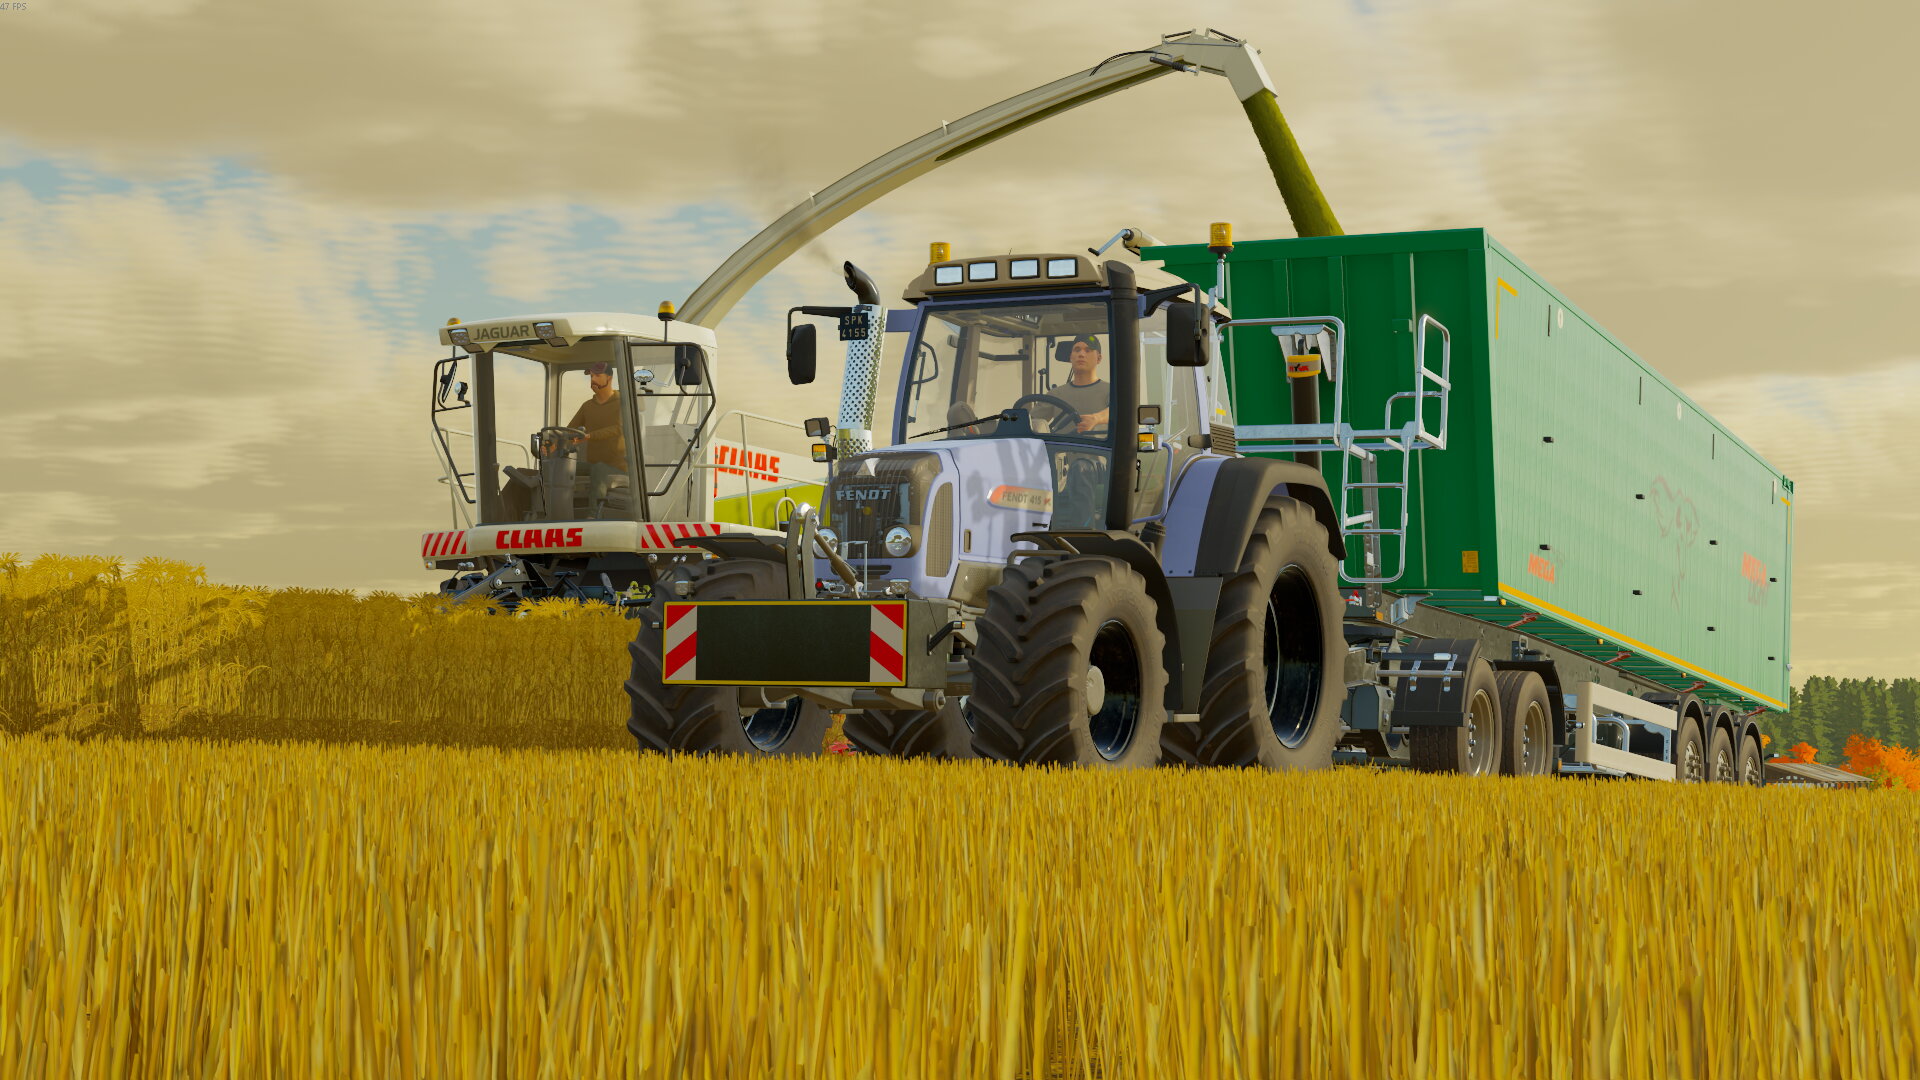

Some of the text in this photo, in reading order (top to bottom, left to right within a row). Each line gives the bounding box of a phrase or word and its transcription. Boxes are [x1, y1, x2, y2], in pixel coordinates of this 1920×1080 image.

[844, 315, 863, 326] SPK
[474, 325, 530, 341] JAGUAR
[841, 327, 866, 338] 4155
[718, 445, 780, 483] CLAAS
[835, 489, 892, 501] FENDT
[1002, 490, 1028, 504] FENDT
[496, 527, 584, 550] CLAAS
[1527, 552, 1555, 584] MEGA
